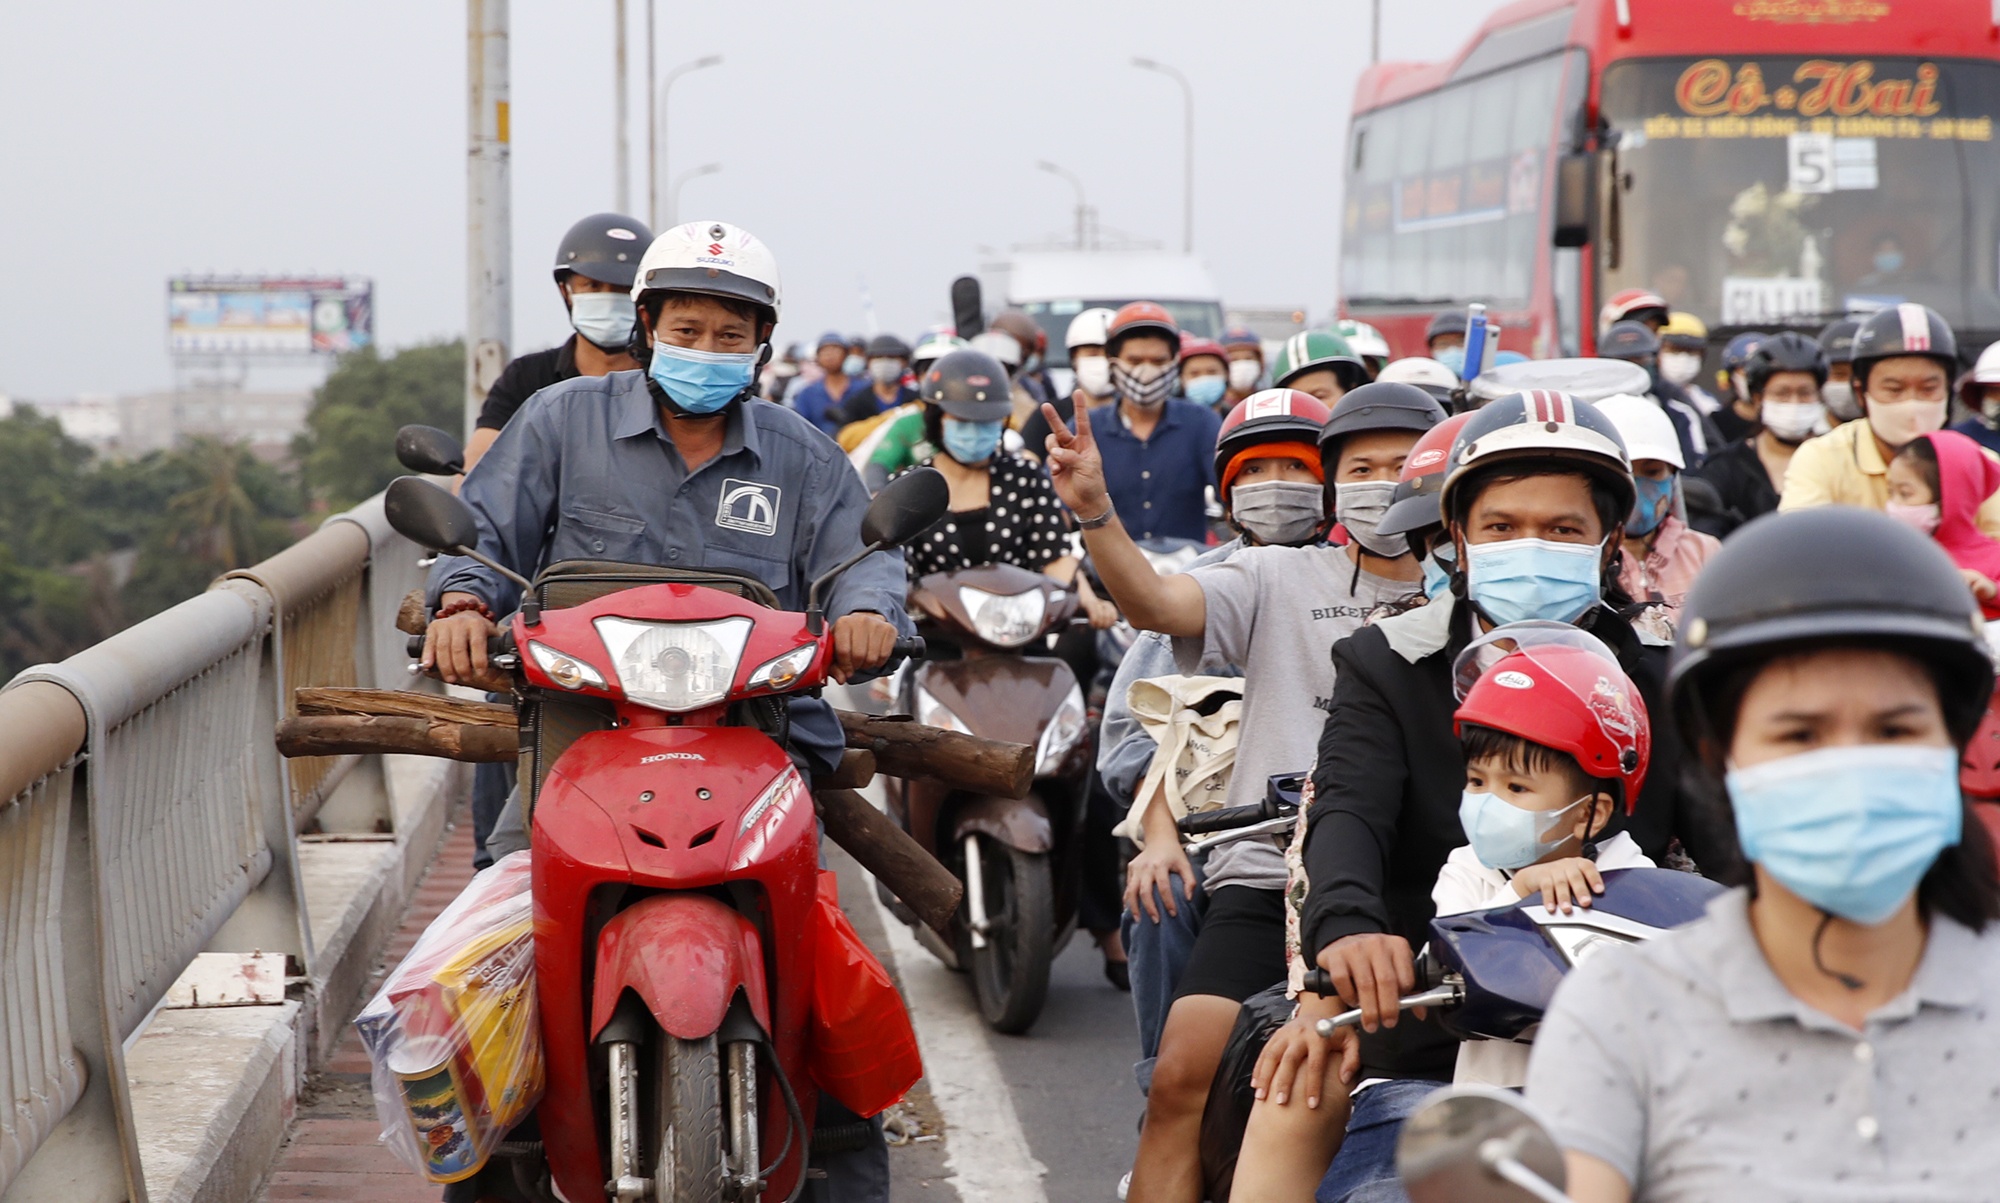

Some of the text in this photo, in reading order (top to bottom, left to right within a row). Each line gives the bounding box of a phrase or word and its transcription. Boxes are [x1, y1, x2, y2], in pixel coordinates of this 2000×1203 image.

[1797, 149, 1825, 186] 5
[696, 256, 735, 267] SUZUKI
[640, 752, 707, 765] HONDA
